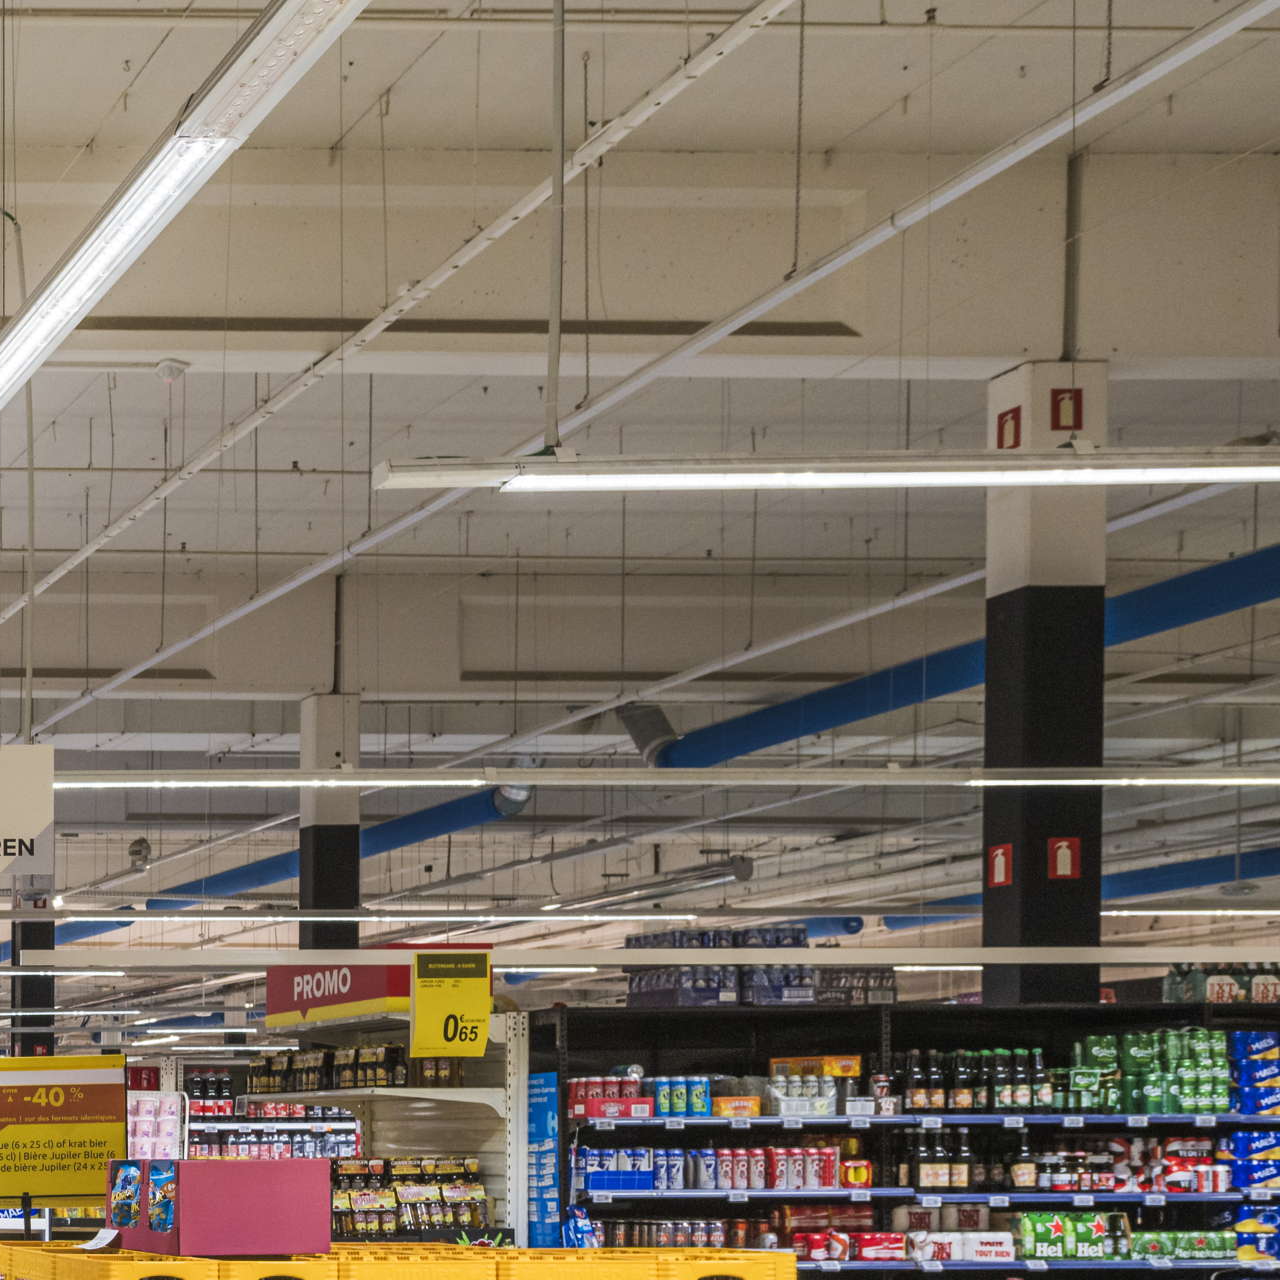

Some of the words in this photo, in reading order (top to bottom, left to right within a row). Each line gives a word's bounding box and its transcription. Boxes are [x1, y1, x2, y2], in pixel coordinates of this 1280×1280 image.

[294, 967, 351, 1001] PROMO
[30, 1140, 40, 1149] 25
[56, 1139, 66, 1148] of
[68, 1139, 87, 1148] krat
[89, 1139, 107, 1148] bier
[23, 1151, 48, 1161] Bière
[51, 1151, 82, 1161] Jupiler
[83, 1150, 105, 1159] Blue
[0, 1164, 12, 1172] de
[14, 1163, 38, 1172] bière
[40, 1162, 71, 1172] Jupiler
